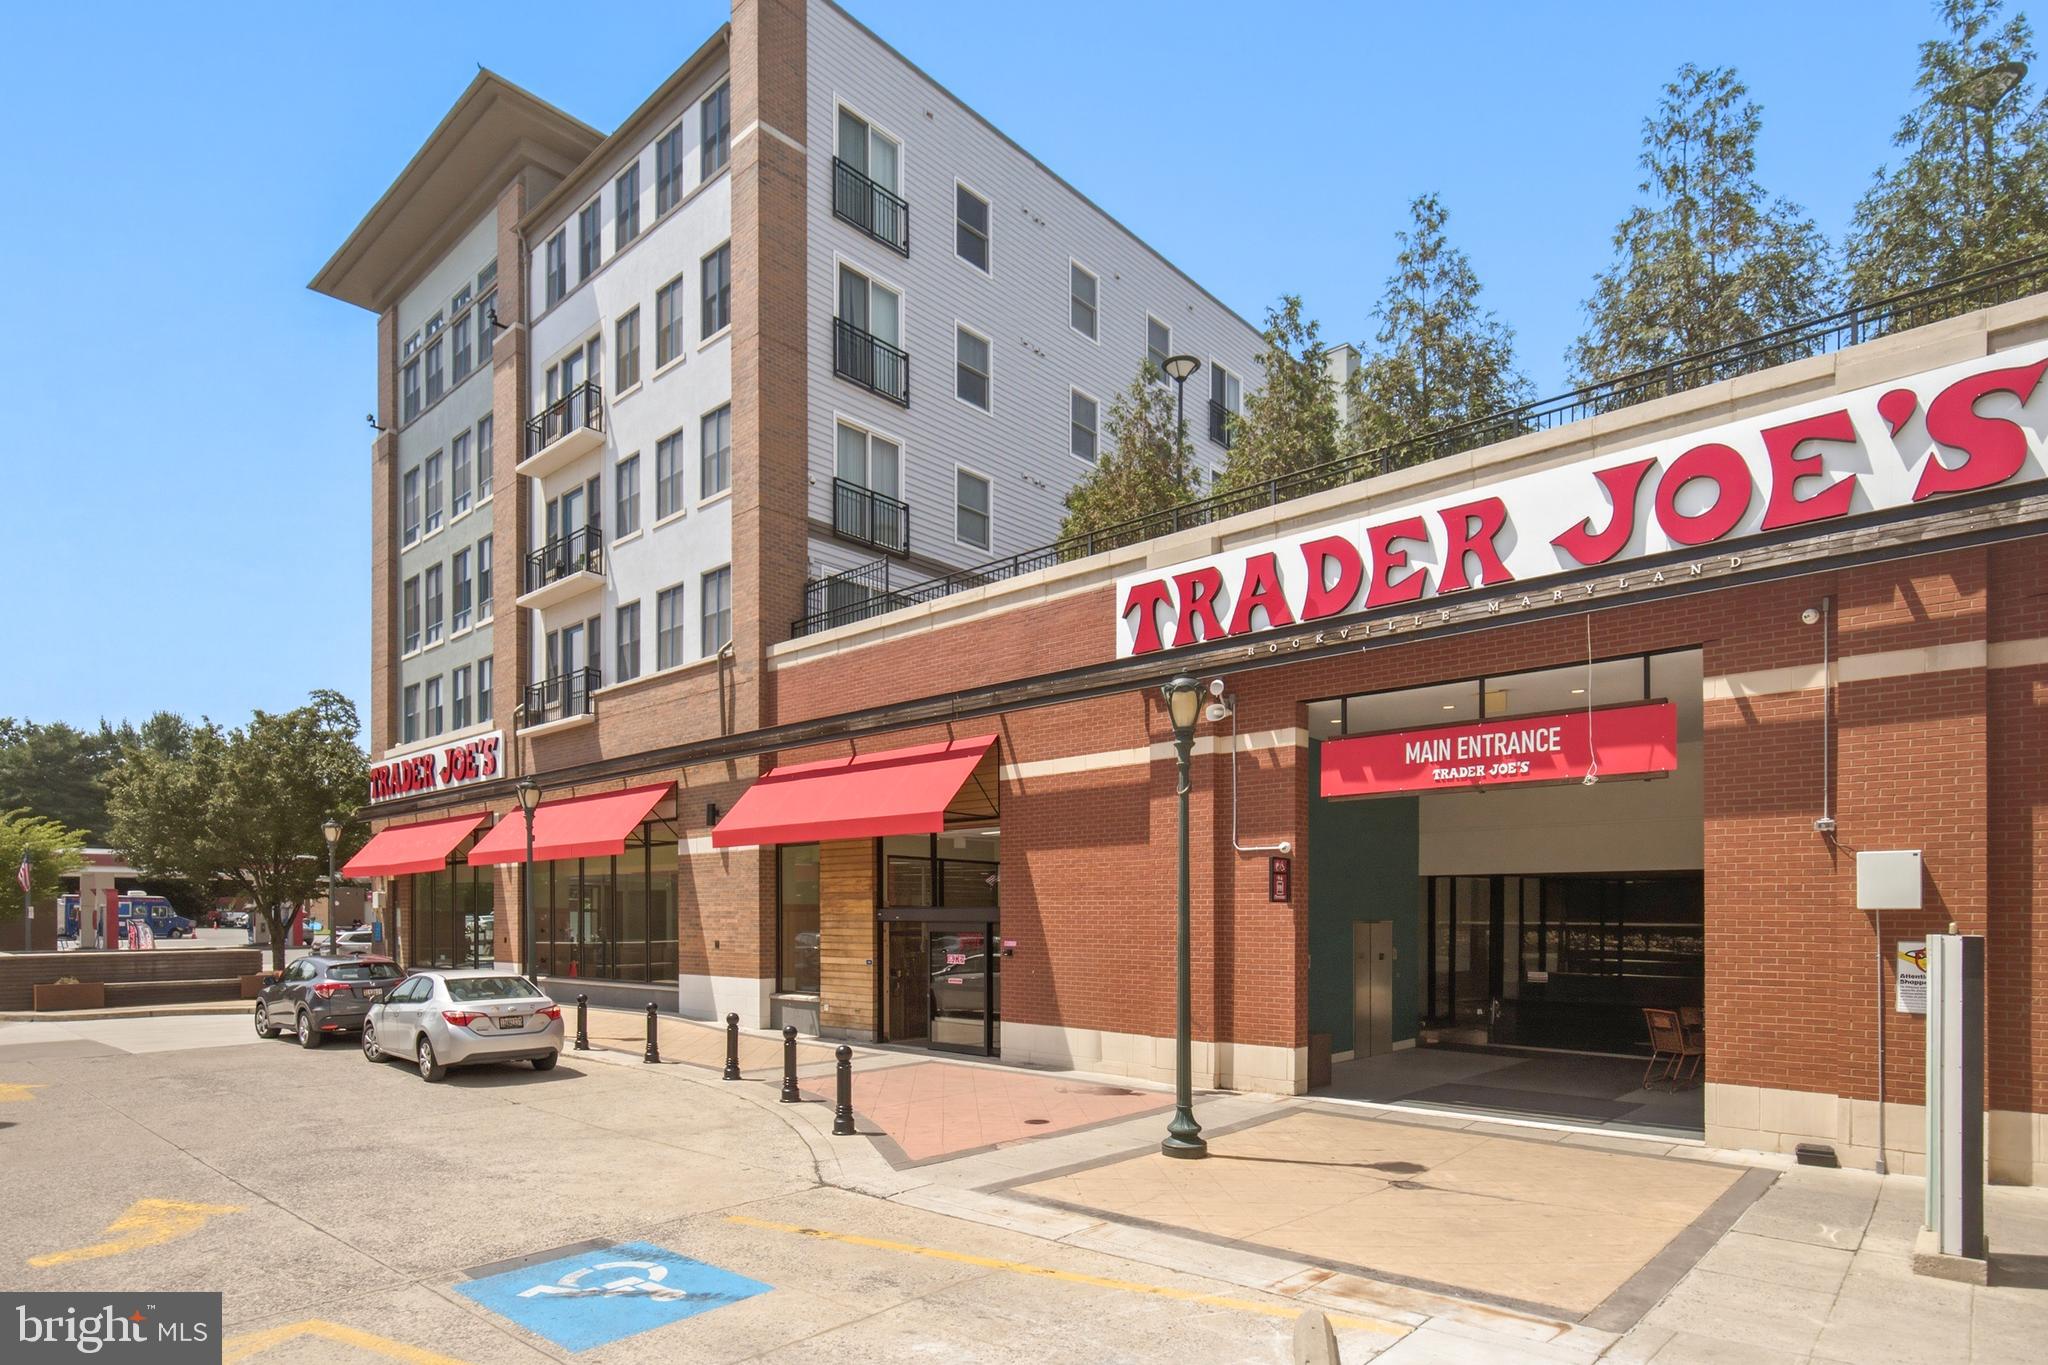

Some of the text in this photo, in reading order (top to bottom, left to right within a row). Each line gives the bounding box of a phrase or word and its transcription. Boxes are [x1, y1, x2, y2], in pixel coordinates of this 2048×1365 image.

[1123, 358, 2048, 655] TRADER JOE'S
[1247, 556, 1742, 656] ROCKVILLE MARYLAND
[370, 736, 499, 799] TRADER JOE'S
[1405, 726, 1561, 765] MAIN ENTRANCE
[1432, 761, 1530, 781] TRADER JOE'S
